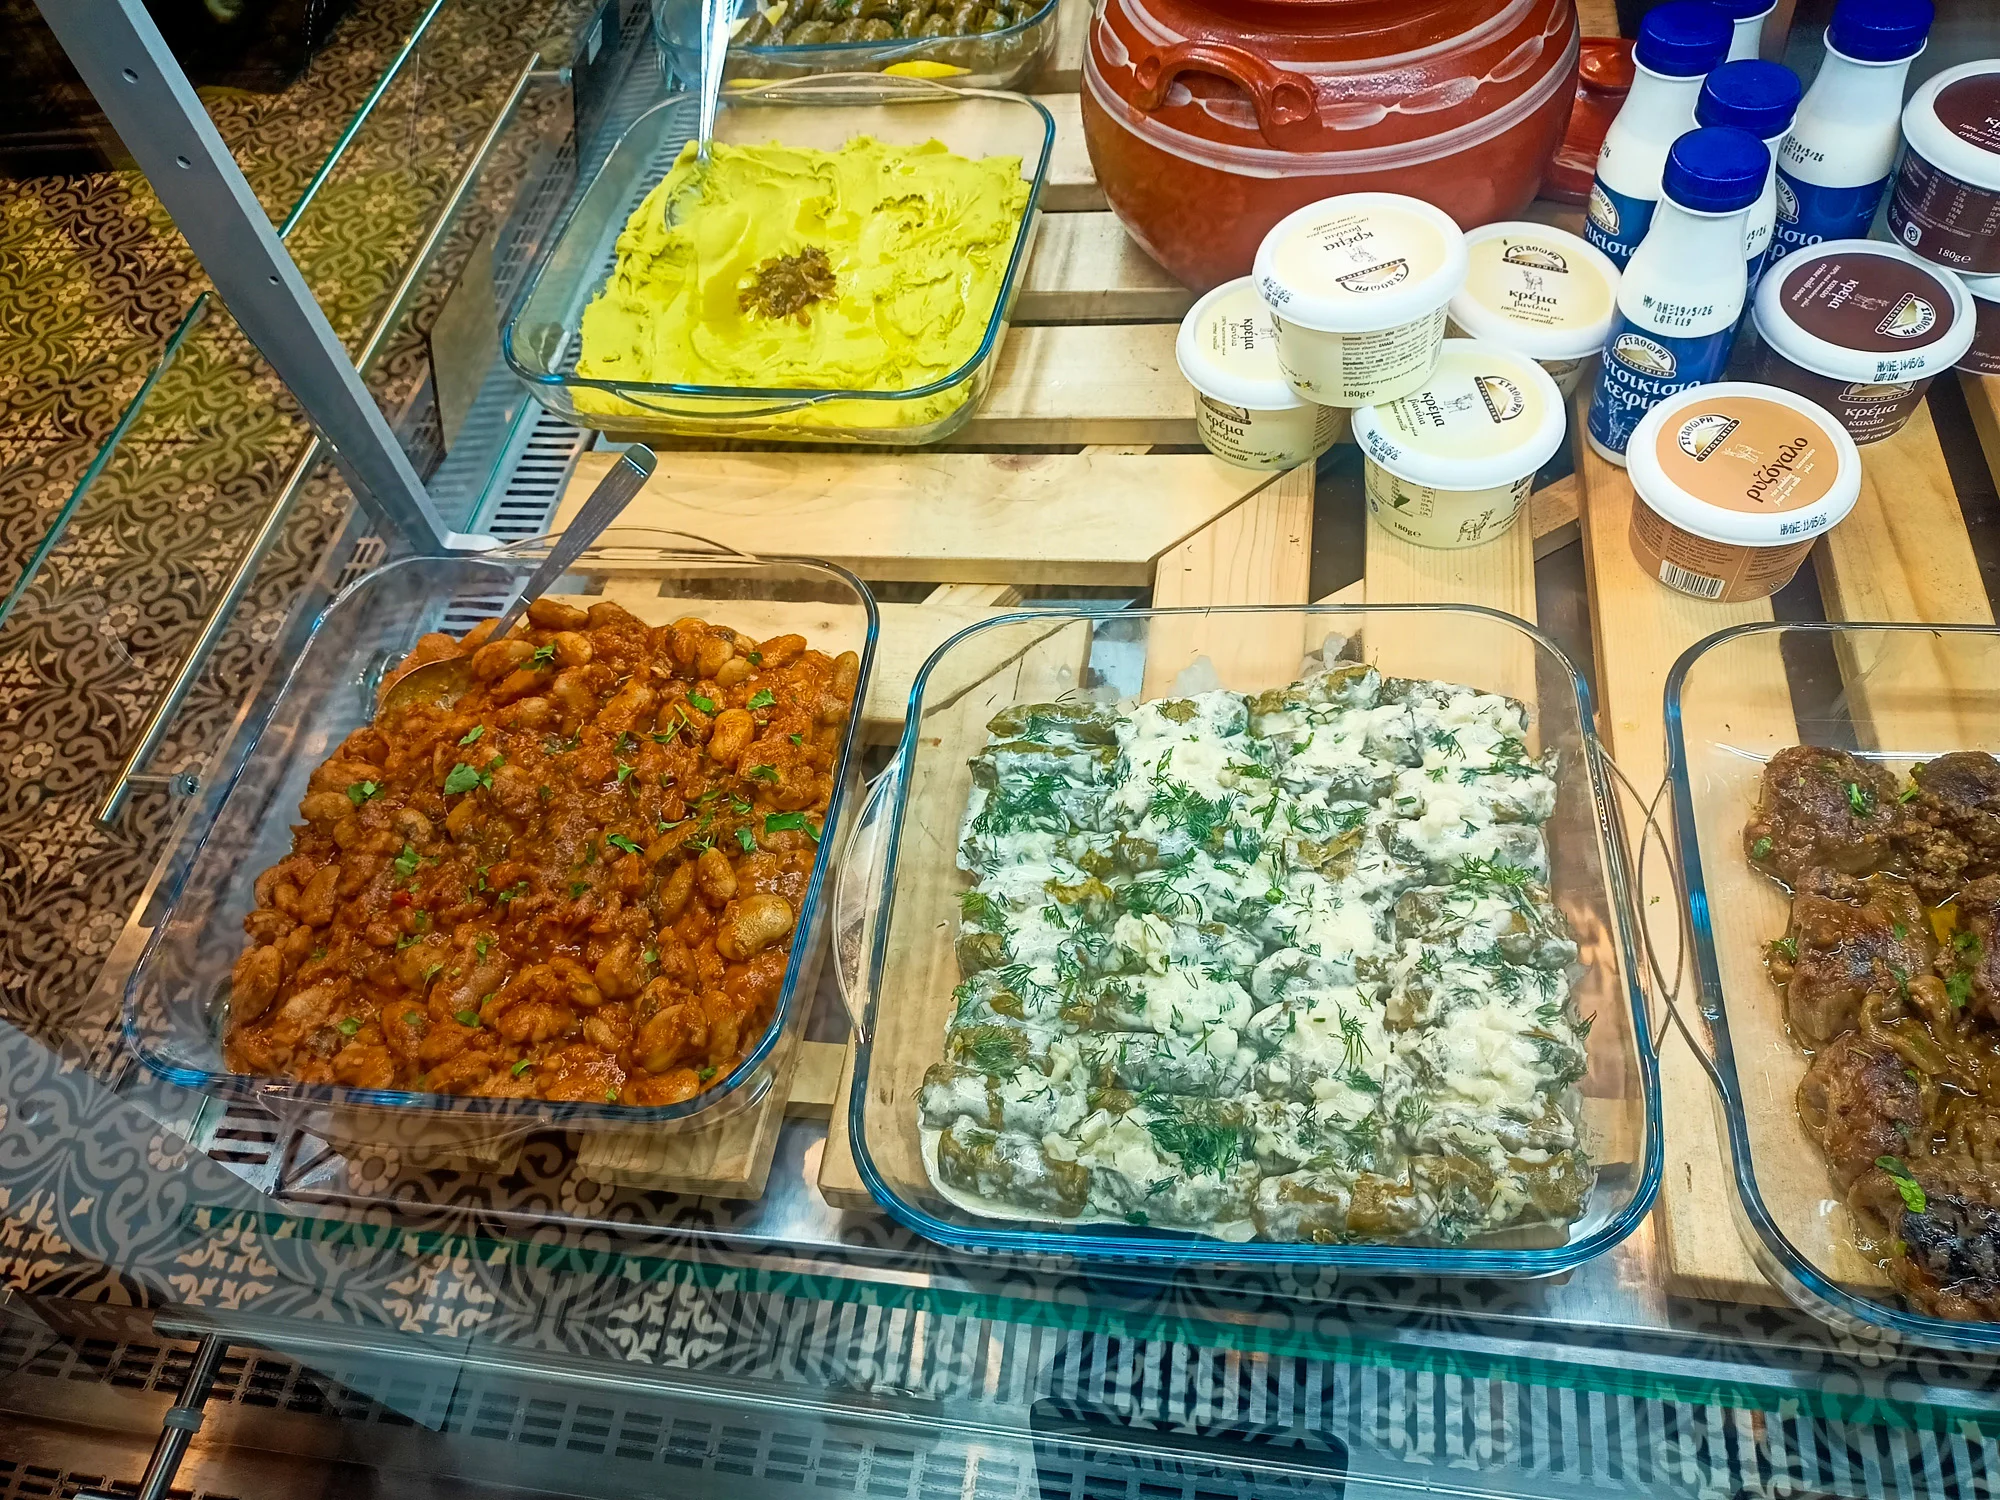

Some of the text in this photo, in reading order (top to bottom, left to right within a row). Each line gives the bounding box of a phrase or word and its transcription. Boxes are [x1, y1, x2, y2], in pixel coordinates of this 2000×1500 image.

[1323, 231, 1374, 252] κρέμα
[1509, 290, 1558, 305] κρέμα
[1820, 280, 1839, 299] κακάο
[1827, 279, 1860, 310] κρέμα
[1240, 318, 1258, 350] κρέμα
[1422, 391, 1446, 428] κρέμα
[1844, 404, 1898, 420] κρέμα
[1206, 412, 1245, 436] κρέμα
[1848, 416, 1884, 426] κακάο
[1746, 438, 1808, 503] ρυζόγαλο
